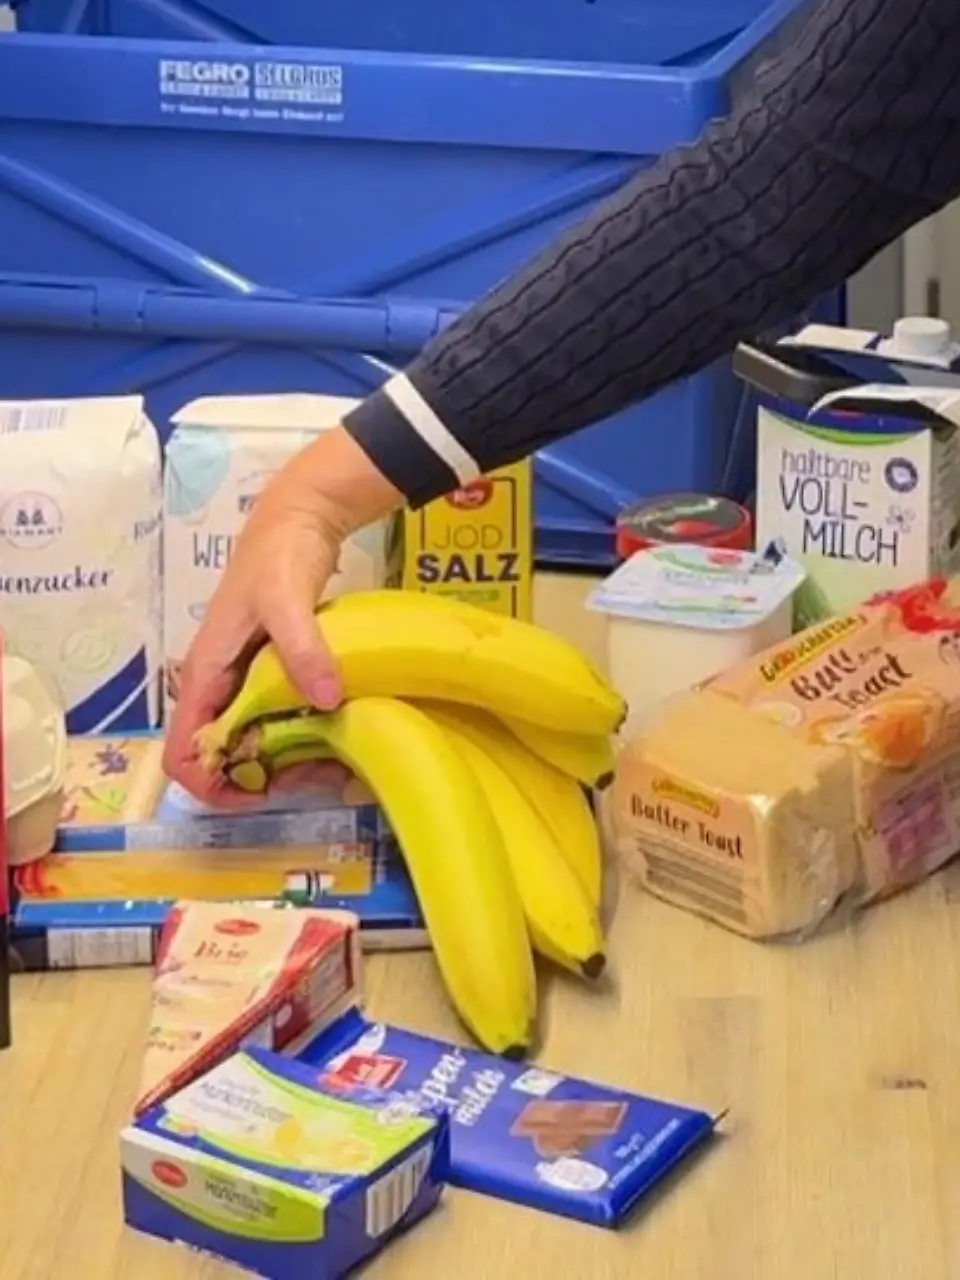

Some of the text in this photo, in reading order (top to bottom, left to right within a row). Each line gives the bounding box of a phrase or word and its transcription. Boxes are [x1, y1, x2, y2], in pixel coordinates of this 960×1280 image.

[781, 448, 871, 484] haltbare
[779, 474, 869, 521] VOLL-
[433, 523, 504, 550] JOD
[803, 518, 899, 568] MILCH
[0, 565, 113, 594] enzucker
[417, 552, 521, 584] SALZ
[828, 652, 913, 710] Toast
[631, 793, 690, 835] Butter
[698, 821, 744, 860] Toast
